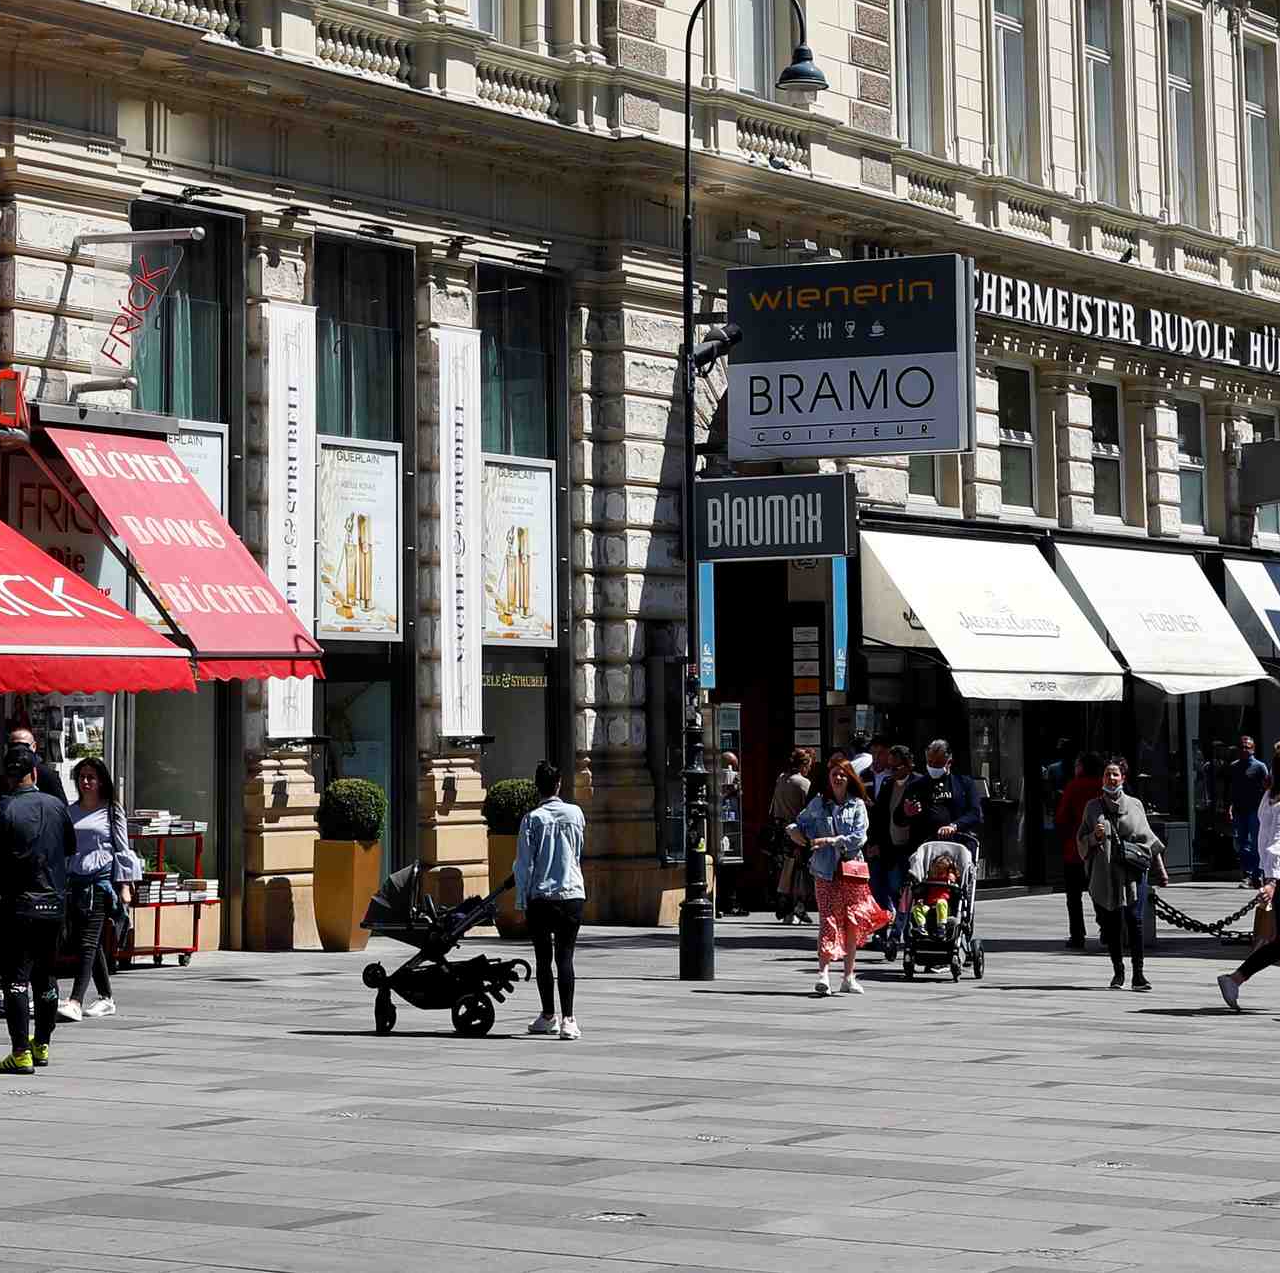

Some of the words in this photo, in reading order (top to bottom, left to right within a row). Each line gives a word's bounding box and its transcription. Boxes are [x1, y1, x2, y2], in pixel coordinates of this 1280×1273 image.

[748, 278, 934, 311] wienerin
[974, 269, 1141, 345] HERMEISTER
[1149, 308, 1239, 365] RUDOLF
[749, 366, 935, 416] BRAMO
[757, 422, 929, 442] COIFFEUR
[66, 439, 189, 484] BÜCHER
[121, 513, 227, 549] BOOKS
[160, 576, 284, 615] BÜCHER
